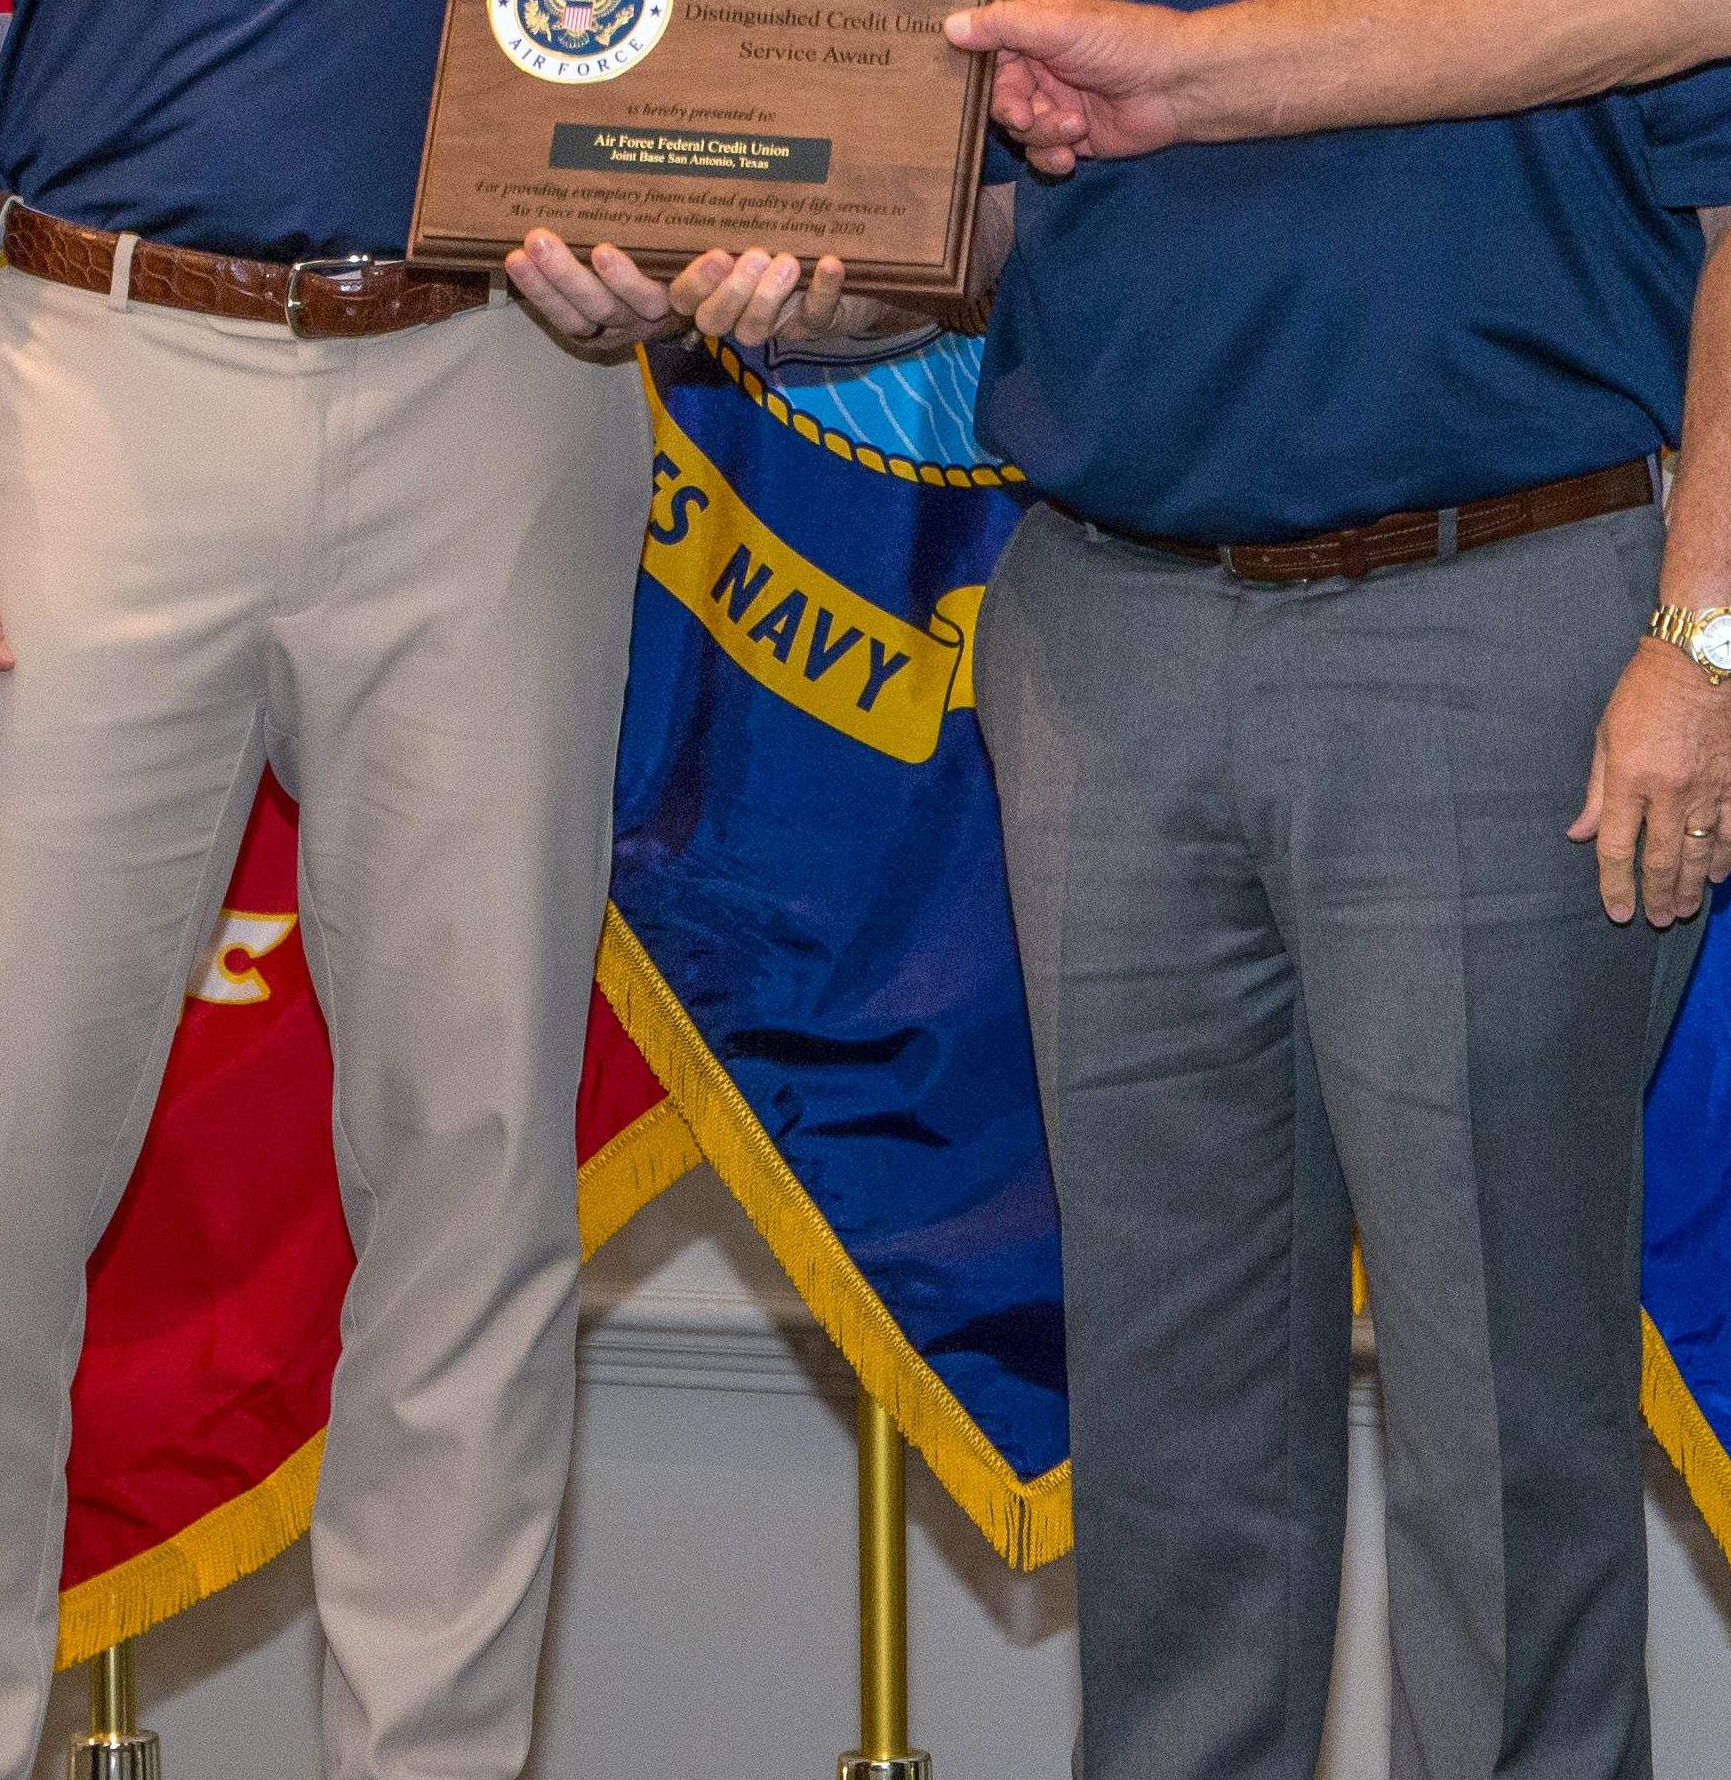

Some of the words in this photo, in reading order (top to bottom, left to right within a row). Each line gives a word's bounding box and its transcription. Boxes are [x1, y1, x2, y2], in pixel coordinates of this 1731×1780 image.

[684, 3, 821, 28] Distinguished
[826, 10, 887, 32] Credit
[895, 14, 944, 35] Unio
[508, 37, 547, 70] AIR
[558, 37, 644, 77] FORCE
[738, 41, 817, 63] Service
[822, 45, 892, 66] Award
[626, 104, 639, 116] is
[642, 103, 687, 121] hereby
[688, 107, 756, 123] presented
[593, 134, 616, 148] Air
[618, 134, 654, 150] Force
[657, 137, 705, 152] Federal
[707, 140, 748, 155] Credit
[750, 143, 790, 158] Union
[609, 149, 637, 162] Joint
[639, 151, 666, 164] Base
[668, 153, 688, 165] San
[689, 154, 736, 169] Antonio,
[738, 158, 770, 170] Texas
[474, 179, 498, 194] For
[502, 181, 568, 200] providing
[571, 187, 643, 204] exemplary
[644, 189, 708, 206] financial
[708, 193, 737, 207] and
[738, 194, 789, 211] quality
[790, 196, 807, 214] of
[809, 196, 833, 215] life
[835, 201, 888, 216] services
[509, 204, 532, 217] Air
[577, 207, 632, 225] military
[634, 210, 663, 225] and
[718, 216, 779, 232] members
[780, 219, 828, 237] during
[828, 221, 867, 236] 2020
[709, 542, 911, 713] NAVY
